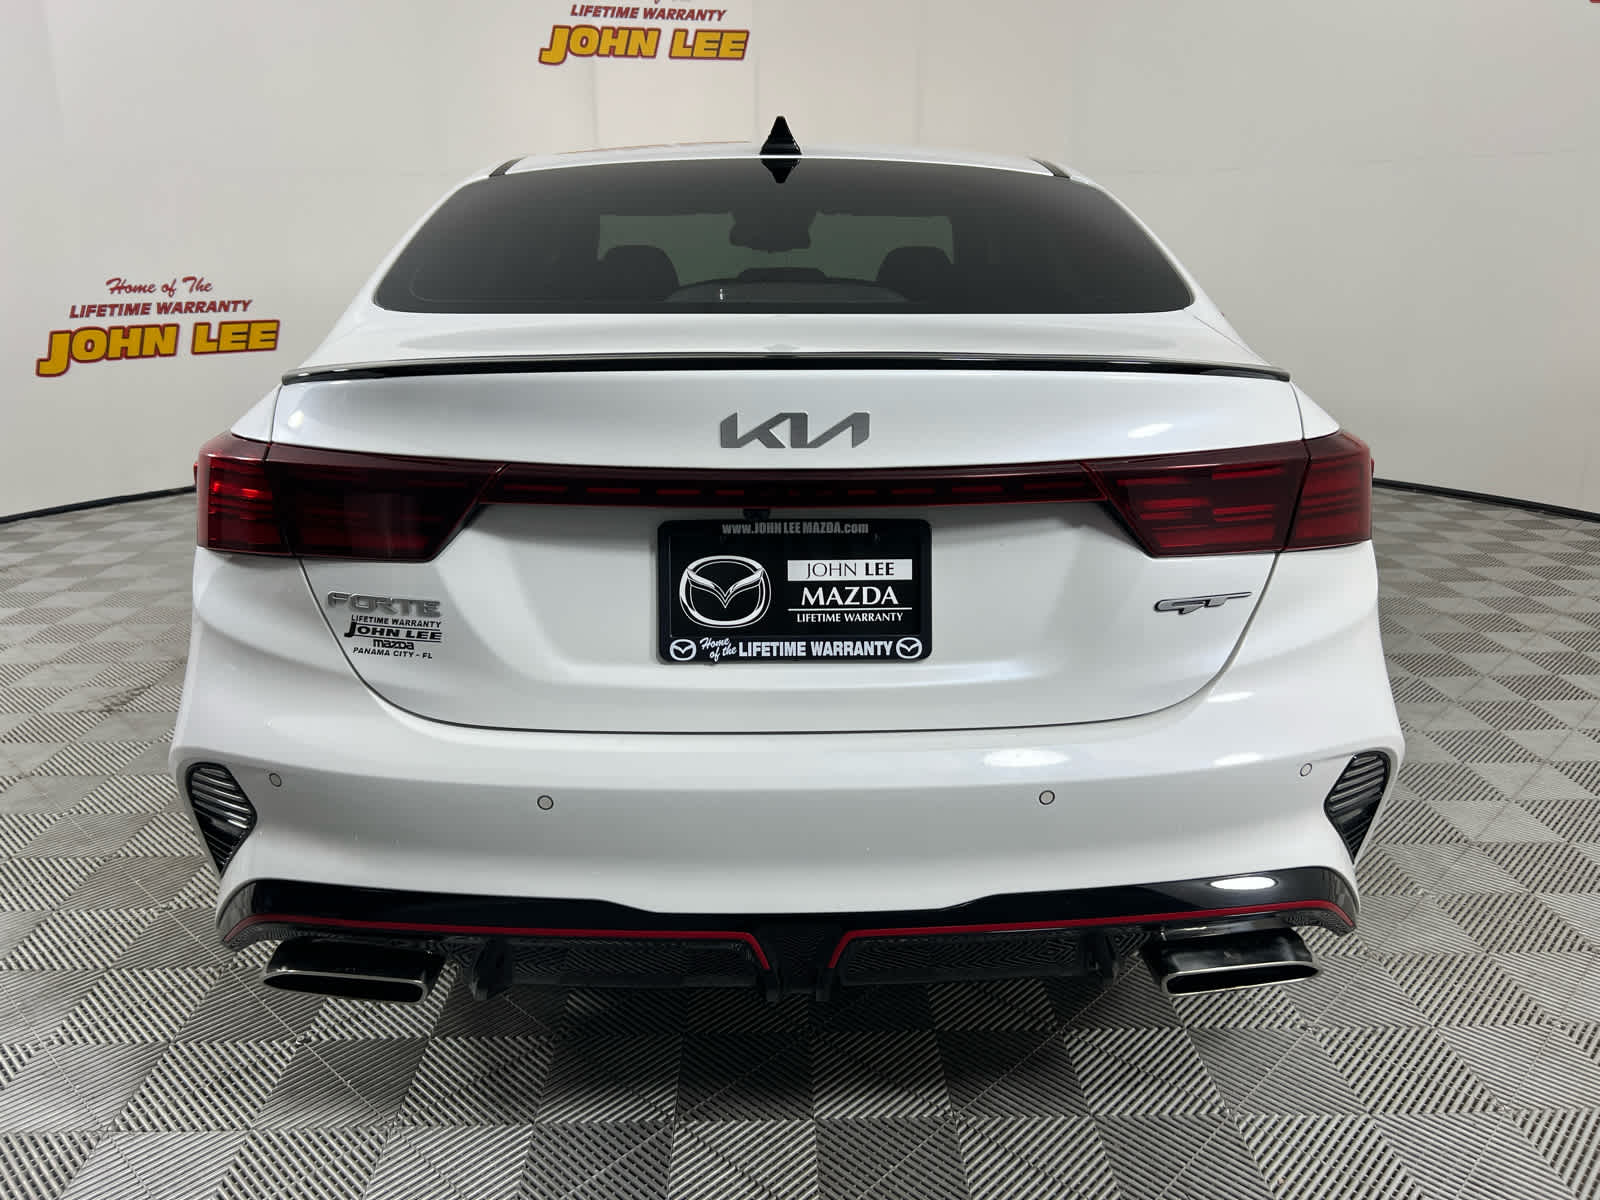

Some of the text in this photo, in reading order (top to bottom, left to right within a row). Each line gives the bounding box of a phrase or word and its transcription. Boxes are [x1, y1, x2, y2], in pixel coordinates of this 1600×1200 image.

[570, 4, 727, 21] LIFETIME WARRANTY
[538, 24, 749, 65] JOHN LEE
[105, 276, 213, 298] Home of The
[69, 300, 252, 318] LIFETIME WARRANTY
[36, 319, 280, 377] JOHN LEE
[720, 412, 870, 448] KIA
[806, 562, 895, 580] JOHN LEE
[327, 591, 442, 618] FORTE
[801, 586, 899, 606] MAZDA
[1153, 591, 1252, 615] GT
[351, 614, 442, 628] LIFETIME WARRANTY
[797, 612, 903, 623] LIFETIME WARRANTY
[344, 622, 442, 640] JOHN LEE
[353, 647, 390, 657] PANAMA
[393, 650, 413, 658] CITY
[700, 637, 730, 650] Home
[738, 640, 893, 657] LIFETIME WARRANTY
[709, 645, 737, 662] of the
